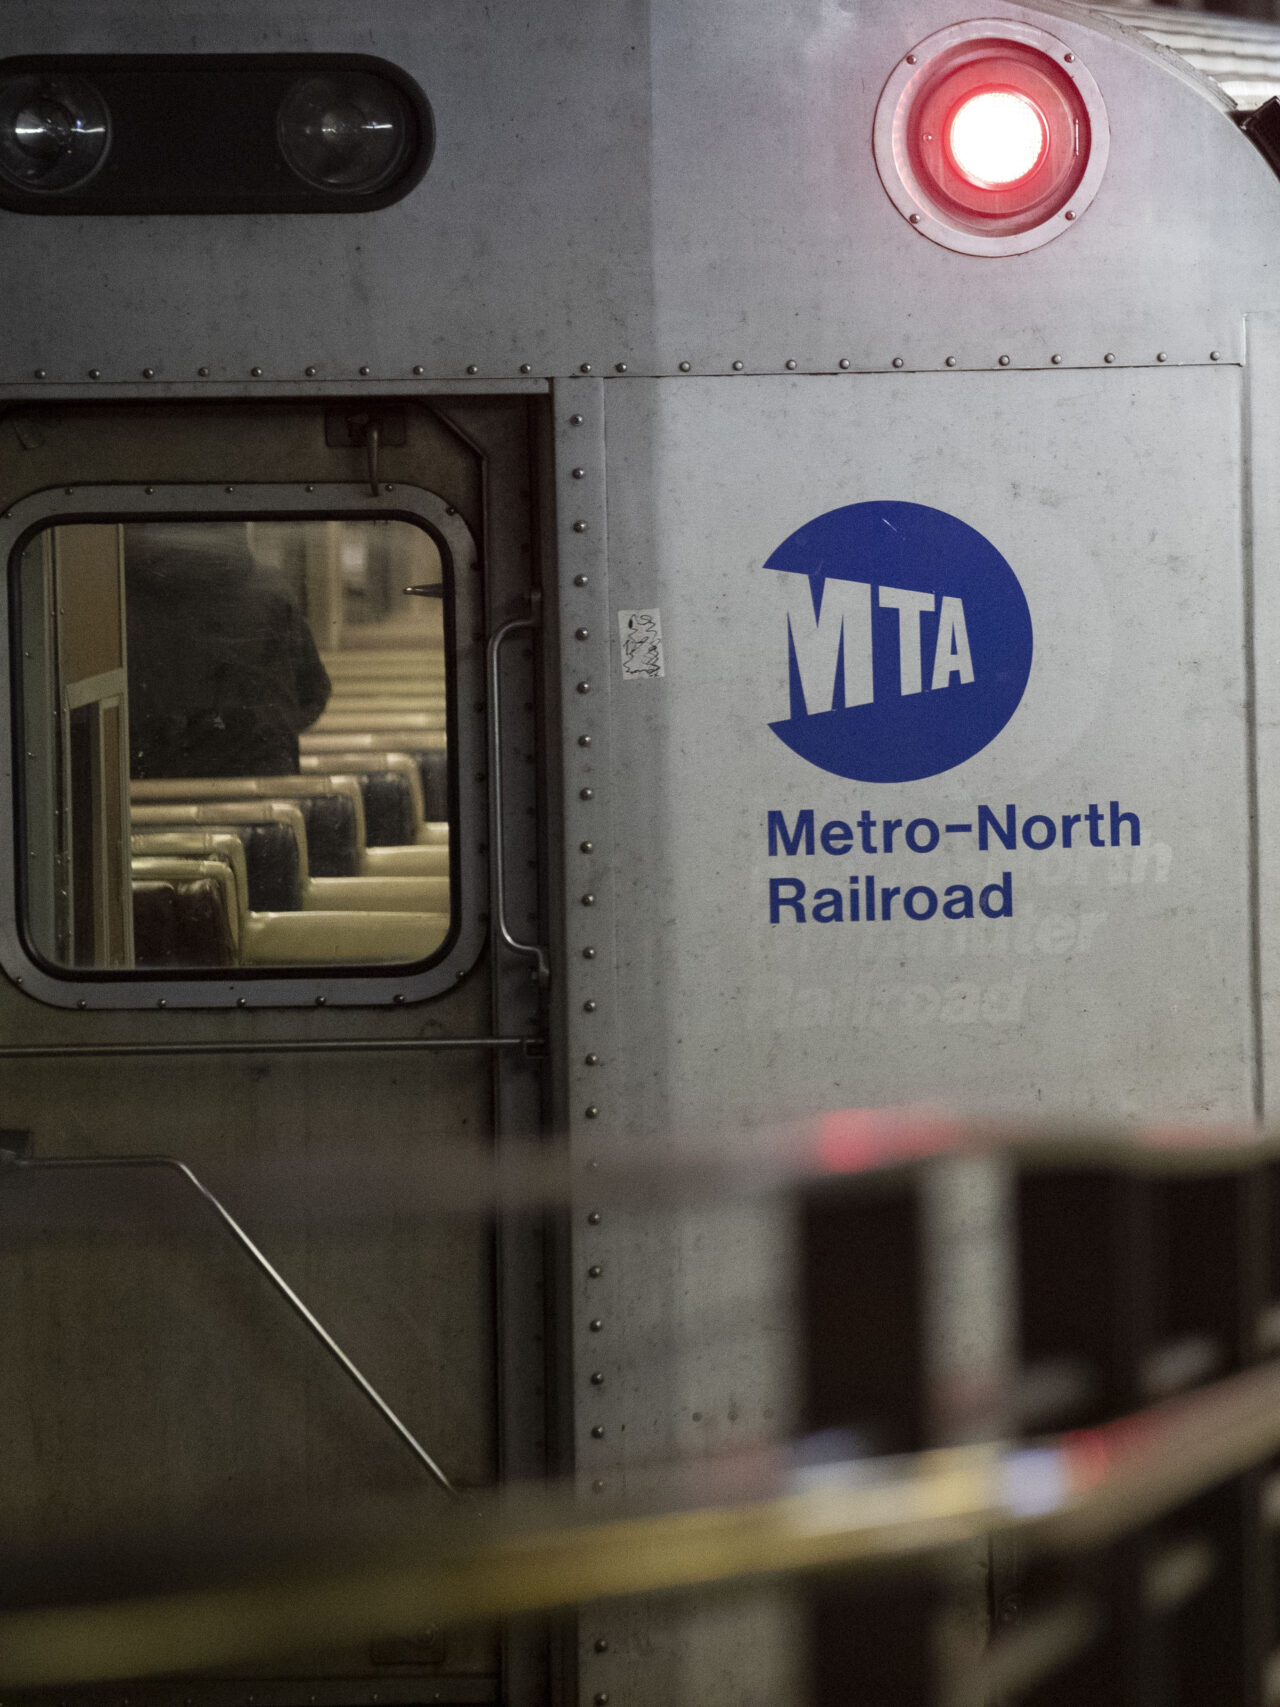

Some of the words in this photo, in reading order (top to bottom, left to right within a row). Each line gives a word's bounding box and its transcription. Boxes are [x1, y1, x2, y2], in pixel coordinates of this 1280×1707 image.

[768, 567, 975, 723] MTA
[767, 801, 1141, 857] Metro-North
[769, 871, 1013, 924] Railroad
